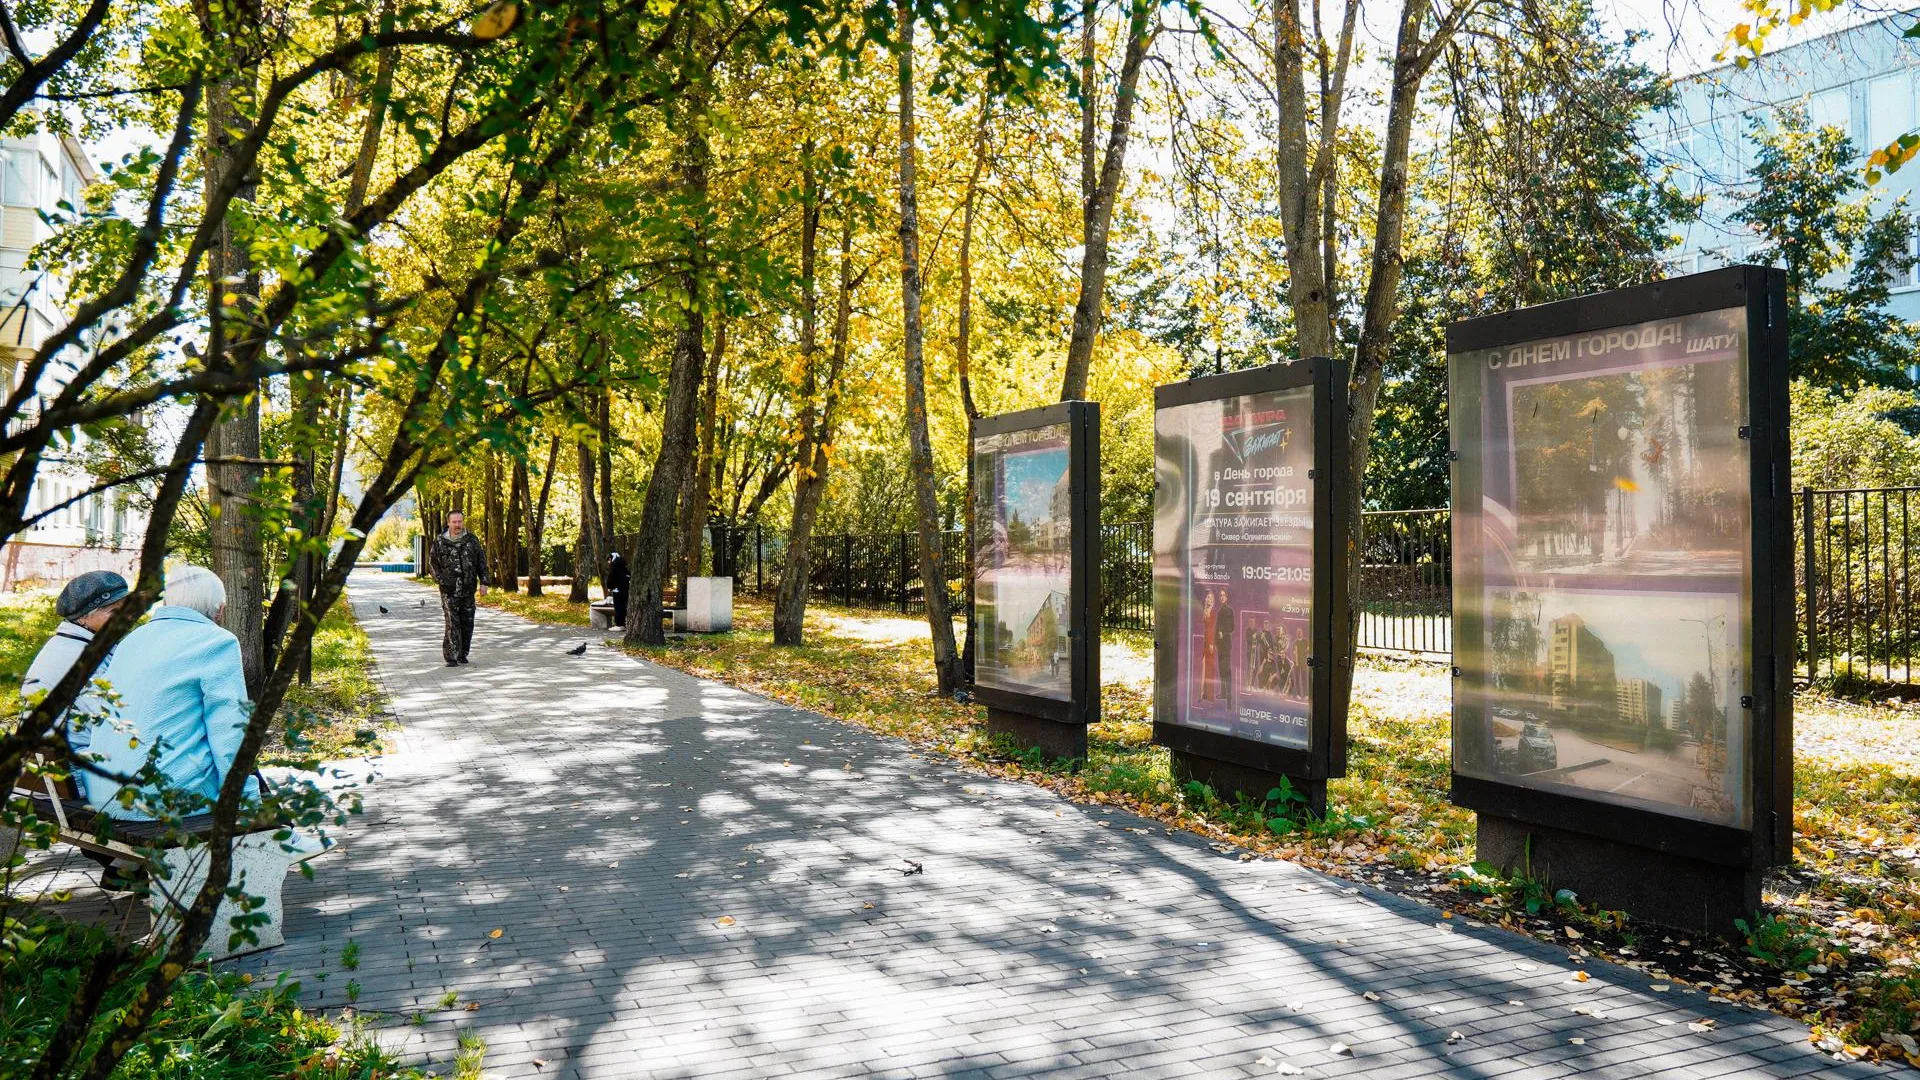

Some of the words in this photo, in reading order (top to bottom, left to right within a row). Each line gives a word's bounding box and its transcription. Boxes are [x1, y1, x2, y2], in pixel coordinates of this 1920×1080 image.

[1507, 341, 1571, 368] ДНЕМ
[1577, 322, 1682, 358] ГОРОДА!
[1686, 332, 1739, 354] ШАТУ
[1214, 471, 1221, 481] в
[1223, 467, 1251, 480] День
[1254, 466, 1294, 481] города
[1204, 488, 1220, 507] 19
[1225, 485, 1307, 508] сентября
[1234, 516, 1273, 528] ЗАЖИГАЕТ
[1221, 533, 1240, 542] Сквер
[1240, 707, 1272, 721] ШАТУРЕ
[1280, 714, 1291, 724] 90
[1292, 716, 1308, 727] ЛЕТ
